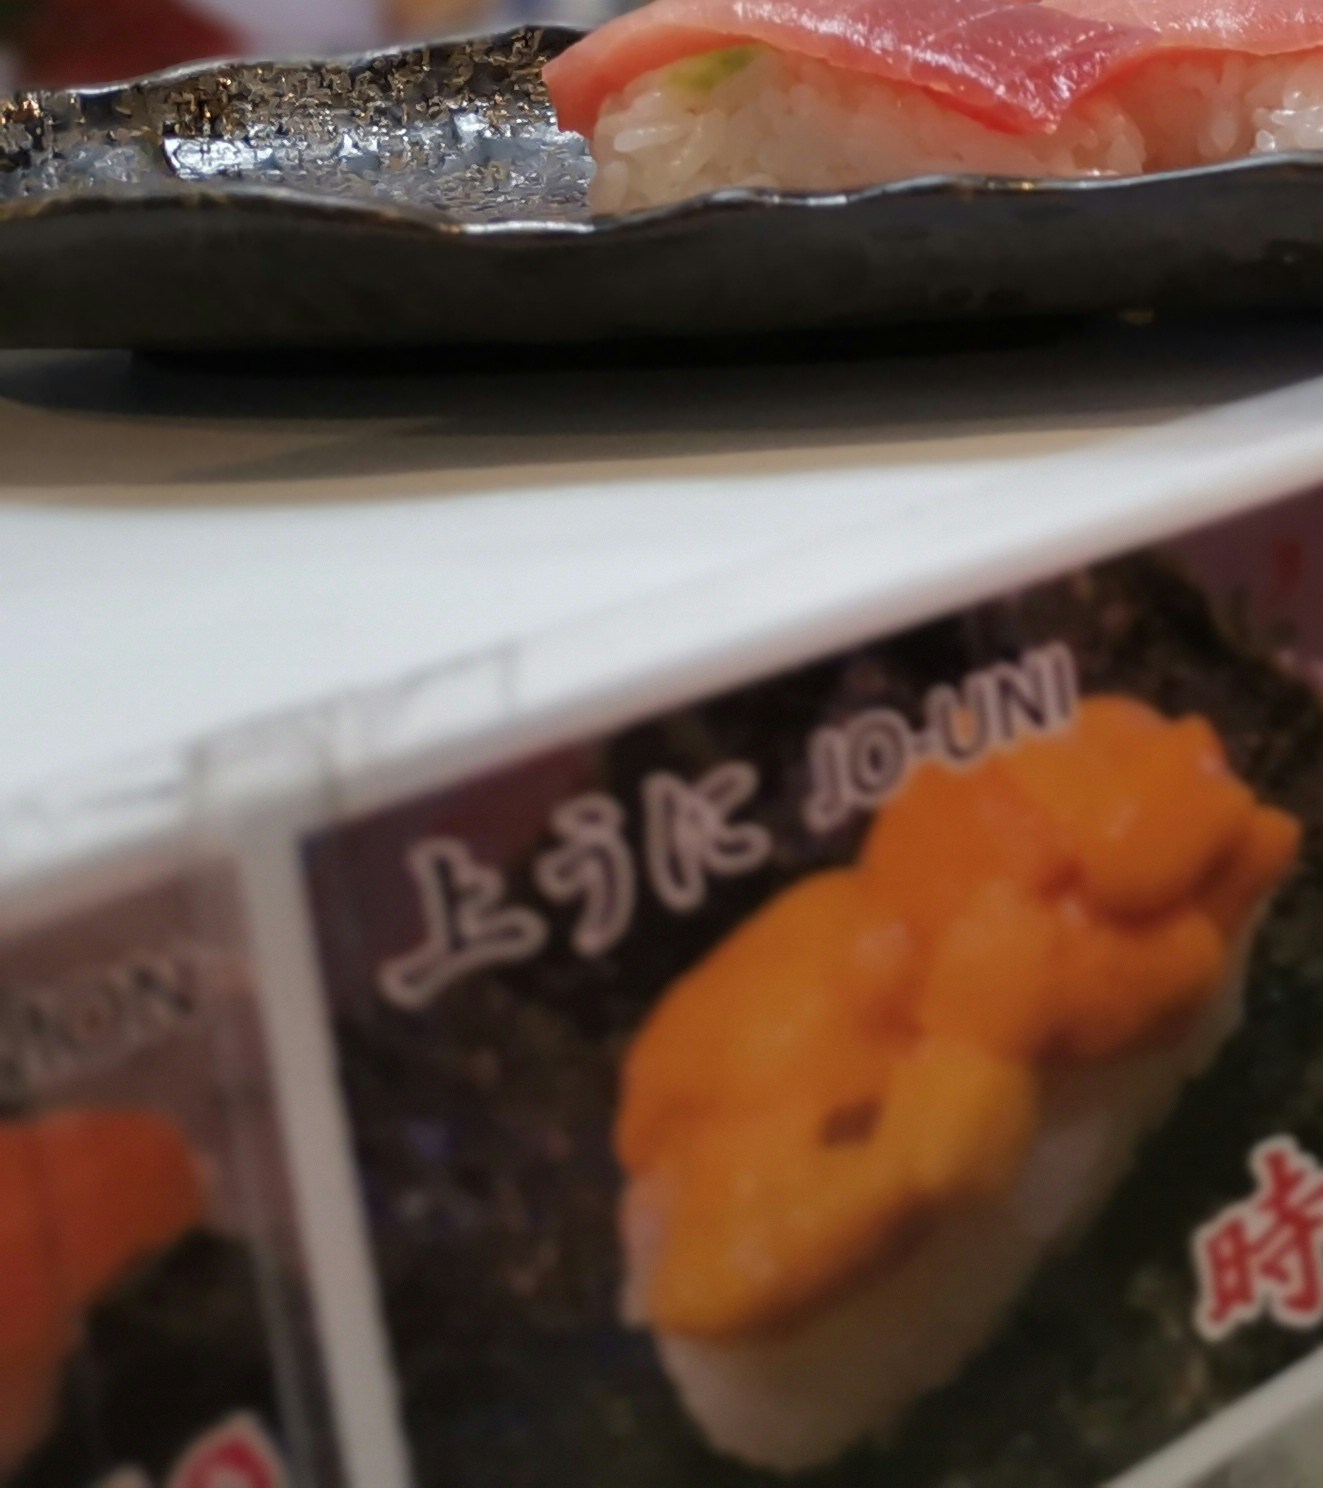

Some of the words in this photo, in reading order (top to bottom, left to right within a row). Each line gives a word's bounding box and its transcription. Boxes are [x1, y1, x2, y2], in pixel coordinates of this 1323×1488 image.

[380, 762, 771, 1008] 上うに
[804, 642, 1078, 834] JO-UNI
